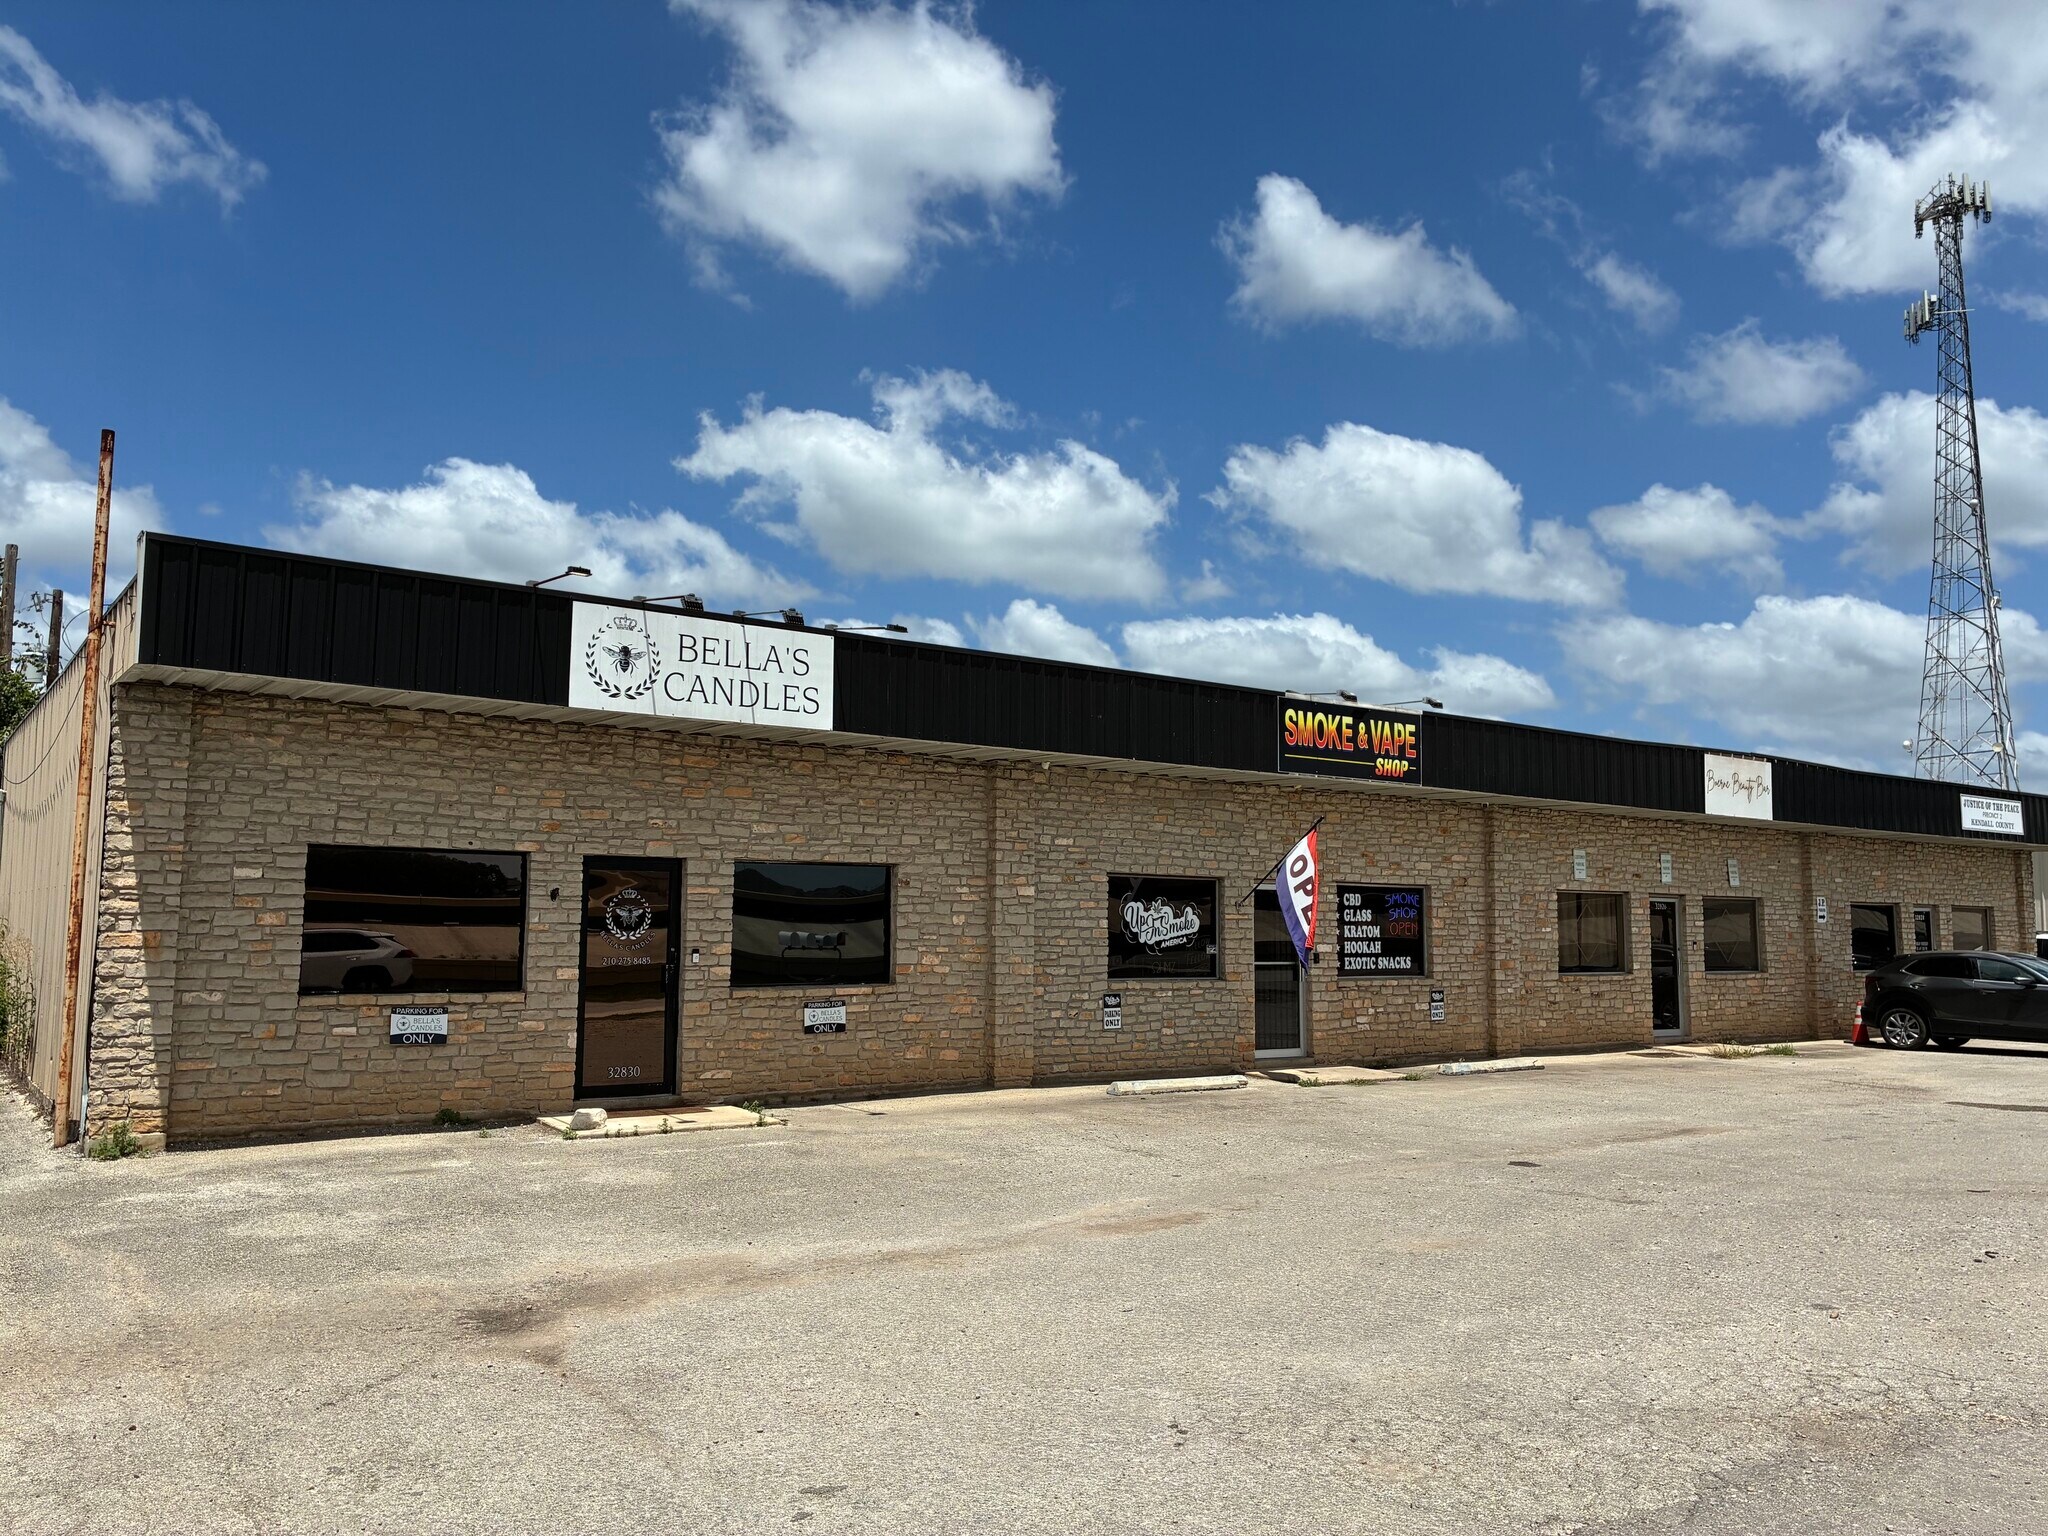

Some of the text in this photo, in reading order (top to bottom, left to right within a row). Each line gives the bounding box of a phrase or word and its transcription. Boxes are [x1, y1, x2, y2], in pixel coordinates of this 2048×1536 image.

[678, 633, 810, 677] BELLA'S
[663, 672, 820, 714] CANDLES
[1285, 709, 1417, 758] SMOKE & VAPE
[1375, 758, 1408, 777] SHOP
[1963, 799, 1985, 809] JUSTICE
[1985, 802, 1991, 810] OF
[1993, 802, 2003, 811] THE
[1971, 818, 2014, 830] KENDALL COUNTY
[1289, 853, 1315, 926] OPE
[1343, 893, 1361, 906] CBD
[1384, 892, 1420, 907] SMOKE
[1343, 909, 1372, 922] GLASS
[1388, 907, 1418, 921] SHOP
[1343, 925, 1380, 938] KRATOM
[1389, 921, 1418, 935] OPEN
[625, 932, 656, 951] CANDLES
[1160, 936, 1188, 949] AMERICA
[1344, 941, 1381, 954] HOOKAH
[1344, 956, 1412, 970] EXOTIC SNACKS
[814, 1024, 837, 1033] ONLY
[1105, 1019, 1120, 1027] ONLY
[403, 1034, 435, 1044] ONLY
[608, 1065, 641, 1079] 32830
